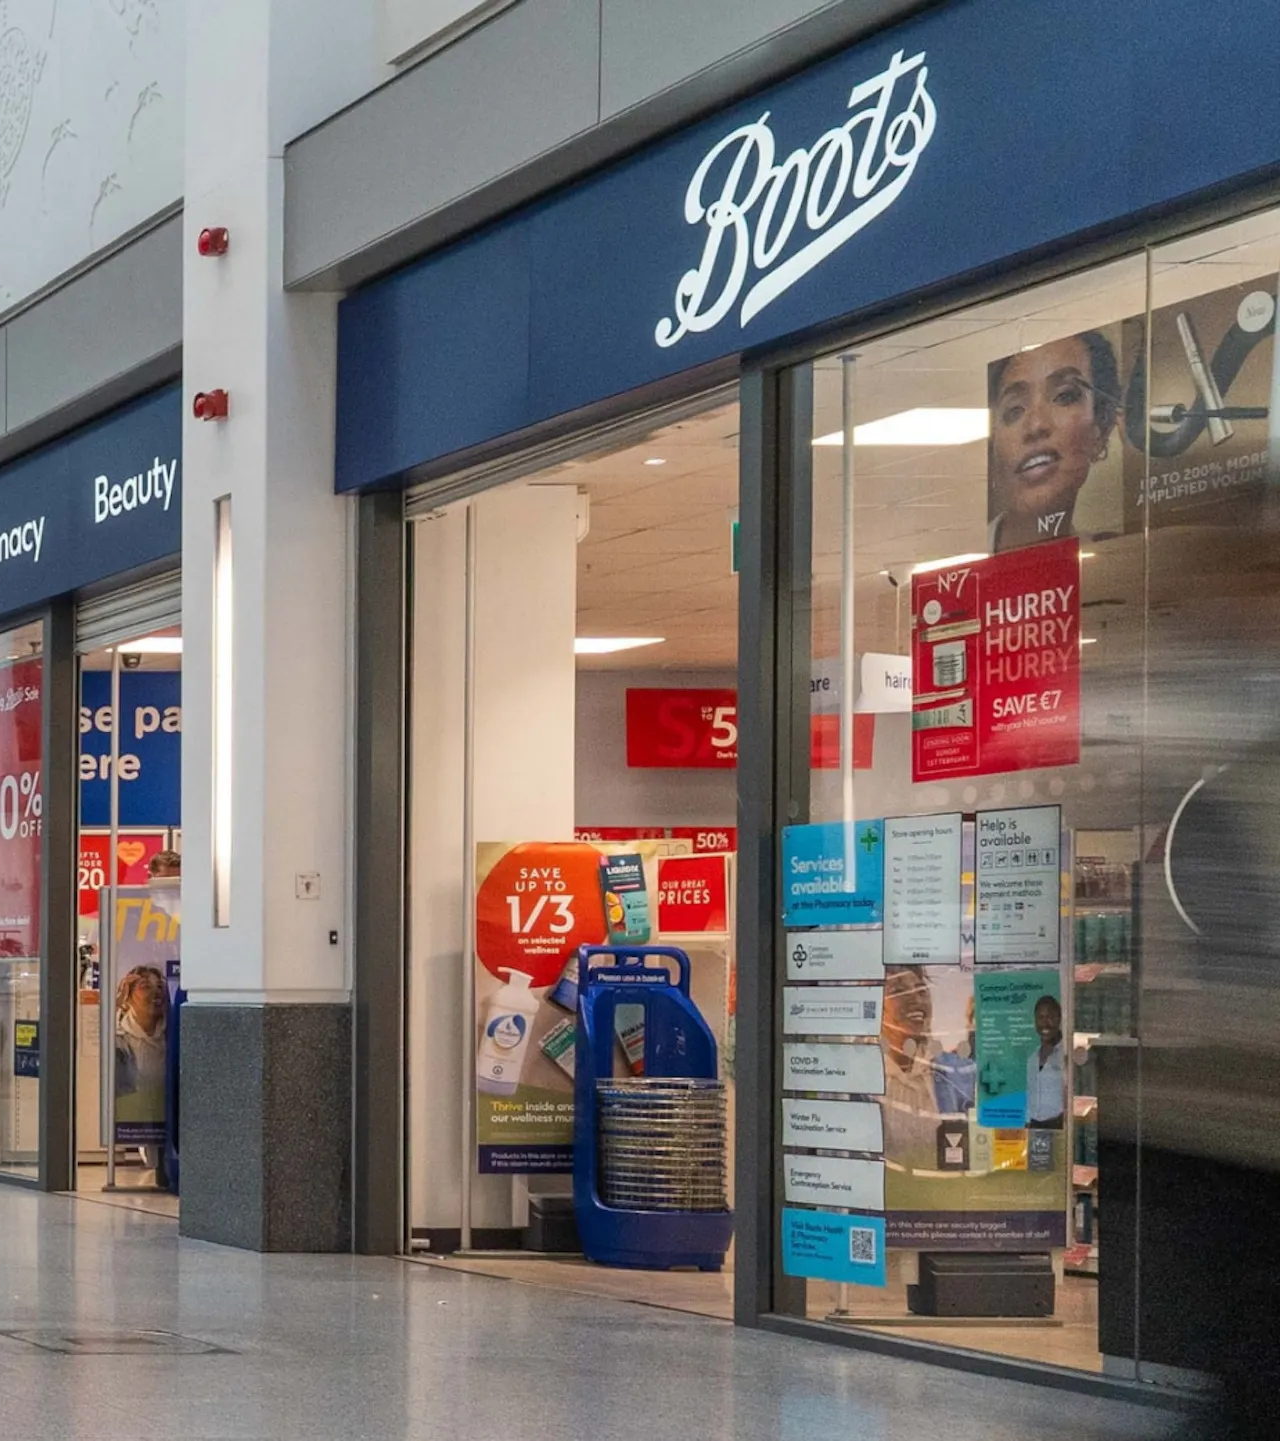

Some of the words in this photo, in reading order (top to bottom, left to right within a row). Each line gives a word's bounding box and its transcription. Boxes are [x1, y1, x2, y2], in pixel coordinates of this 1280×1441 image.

[655, 49, 937, 347] Boots
[1161, 472, 1180, 485] TO
[1184, 461, 1222, 479] 200%
[1226, 451, 1268, 472] MORE
[94, 456, 177, 523] Beauty
[986, 585, 1074, 627] HURRY
[986, 615, 1074, 656] HURRY
[986, 647, 1074, 685] HURRY
[992, 693, 1037, 718] SAVE
[1040, 689, 1061, 710] €7
[135, 706, 181, 739] pa
[79, 753, 140, 781] ere
[980, 819, 1006, 834] Help
[1009, 817, 1017, 829] is
[696, 832, 728, 848] 50%
[980, 832, 1032, 847] available
[520, 868, 561, 879] SAVE
[791, 856, 844, 874] Services
[516, 881, 537, 892] UP
[544, 881, 566, 892] TO
[662, 881, 679, 889] OUR
[681, 880, 706, 889] GREAT
[659, 888, 711, 905] PRICES
[506, 895, 575, 933] 1/3
[531, 936, 566, 945] selected
[524, 946, 560, 955] wellness
[491, 1101, 524, 1111] Thrive
[525, 1101, 555, 1111] inside
[491, 1115, 508, 1123] our
[511, 1113, 553, 1123] wellness
[898, 1221, 912, 1229] this
[914, 1221, 933, 1229] store
[951, 1221, 978, 1231] security
[901, 1231, 929, 1239] sounds
